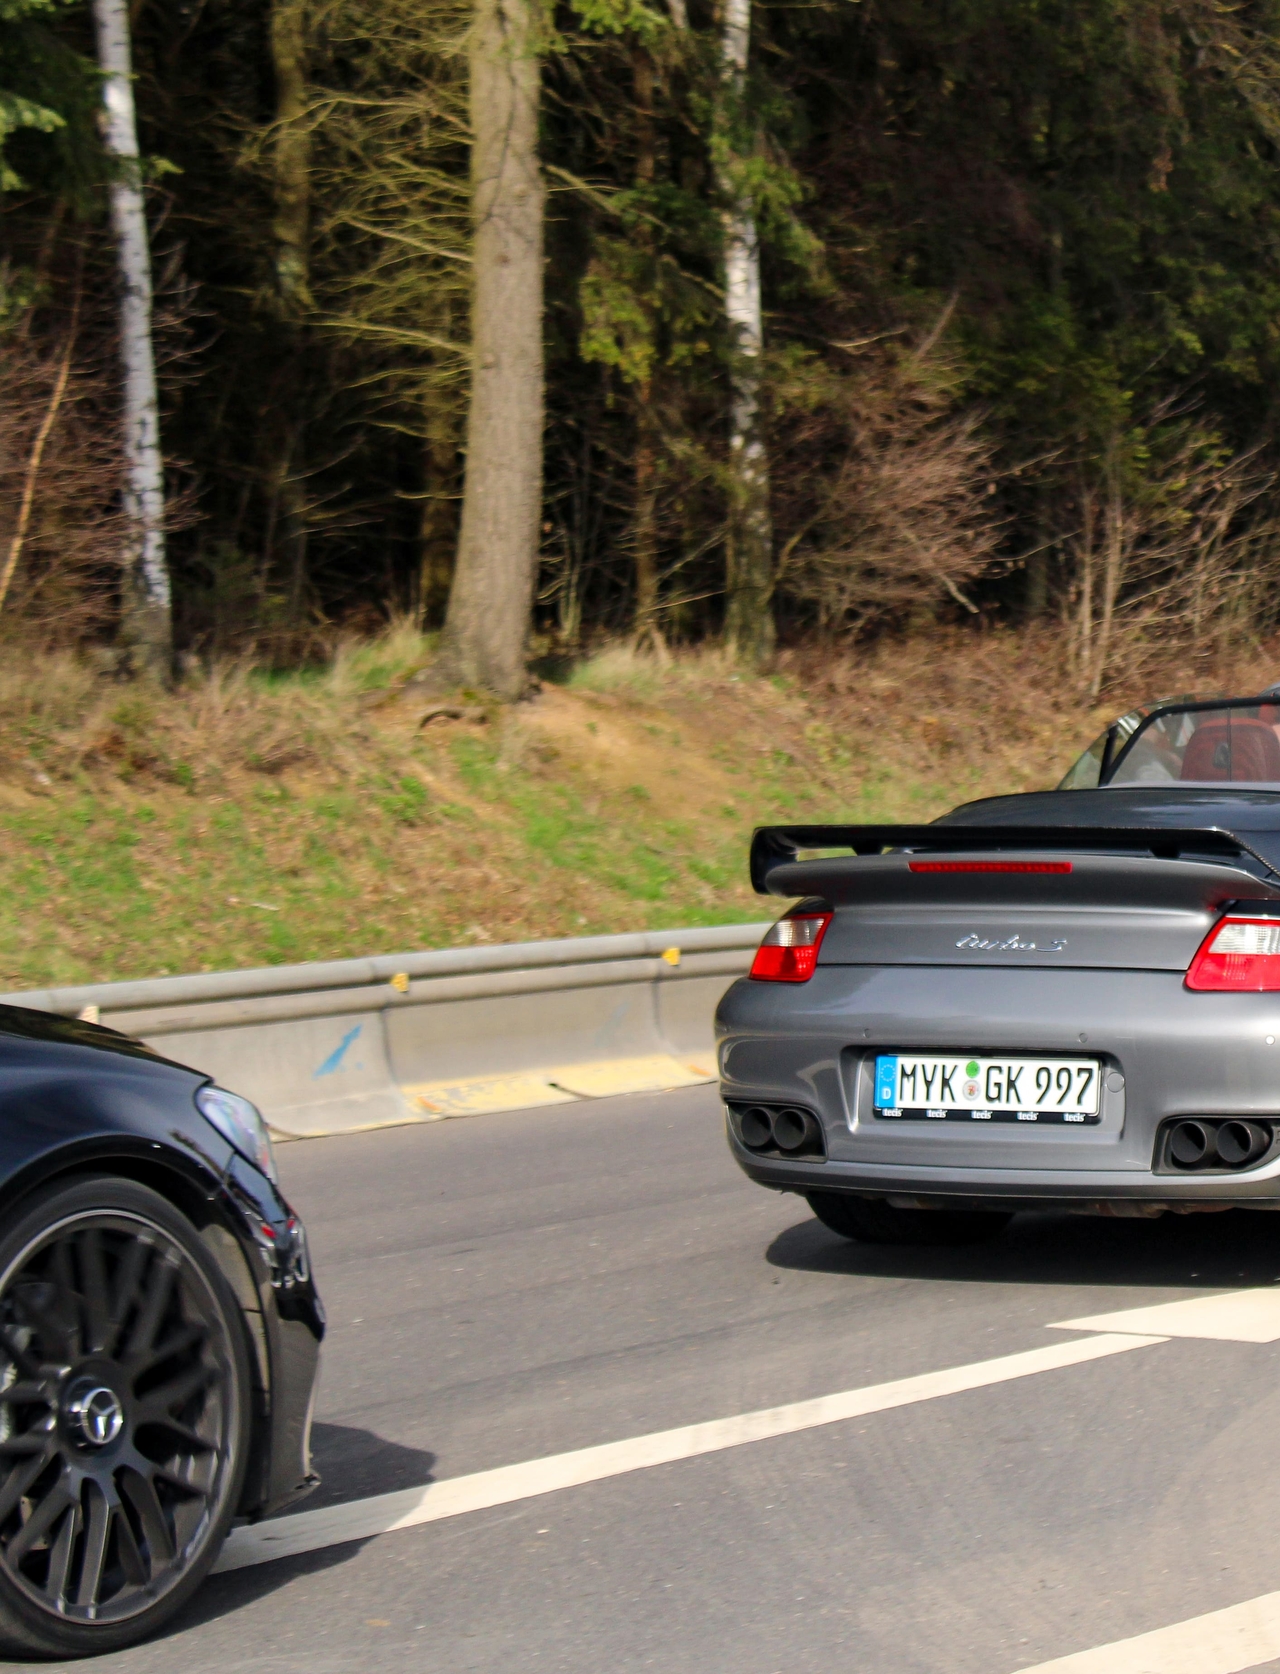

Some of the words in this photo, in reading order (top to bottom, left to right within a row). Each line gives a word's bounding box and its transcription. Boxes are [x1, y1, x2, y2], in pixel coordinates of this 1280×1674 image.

[882, 1088, 891, 1100] D
[900, 1064, 957, 1102] MYK
[985, 1065, 1024, 1104] GK
[1035, 1066, 1093, 1106] 997
